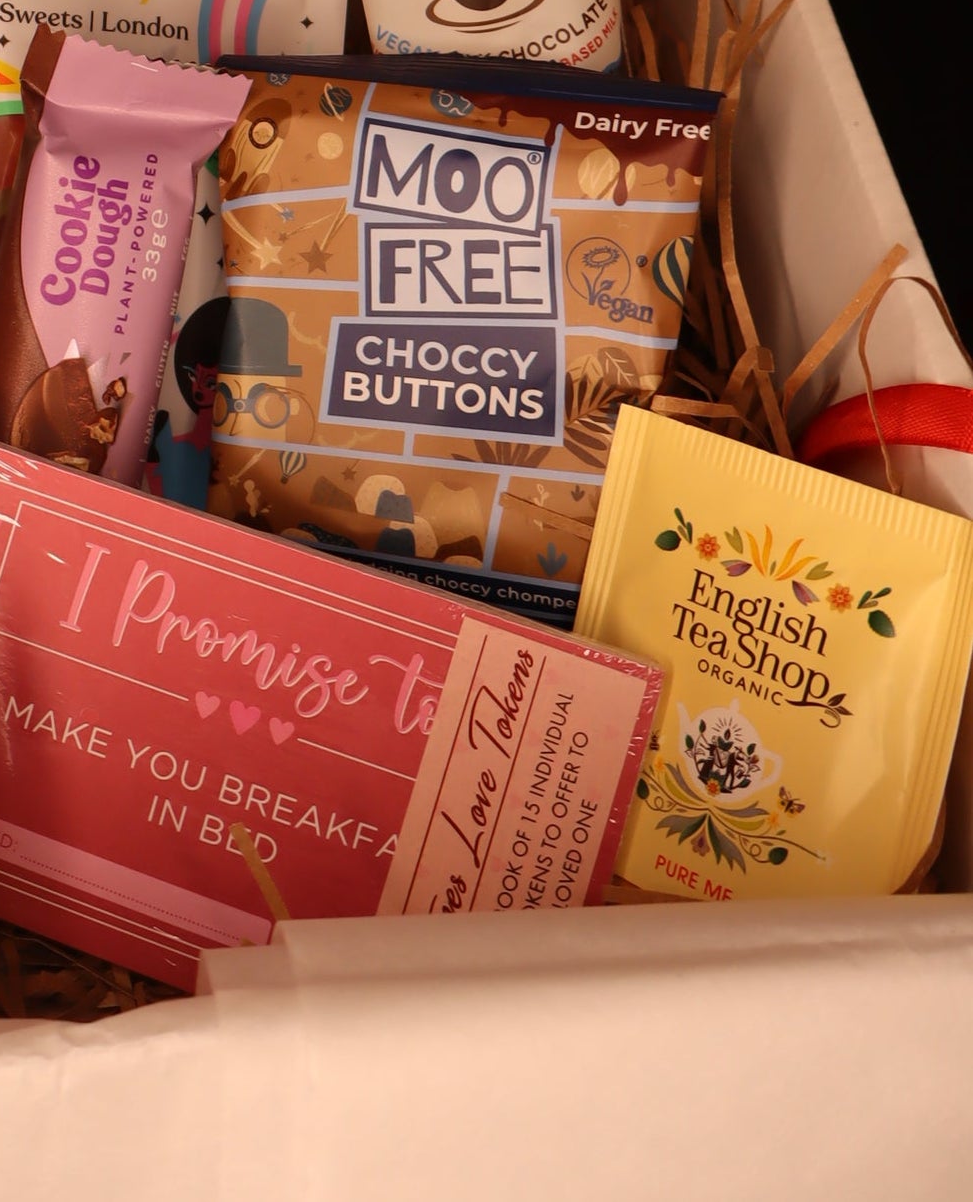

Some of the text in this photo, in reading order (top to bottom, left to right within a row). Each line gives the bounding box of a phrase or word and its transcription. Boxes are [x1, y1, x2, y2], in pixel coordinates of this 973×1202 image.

[101, 11, 190, 41] London
[601, 9, 619, 39] MILK
[574, 111, 711, 141] Dairy Free
[40, 154, 101, 306] Cookie
[79, 178, 133, 296] Dough
[114, 153, 159, 335] PLANT-POWERED
[379, 239, 544, 305] FREE
[584, 282, 654, 324] Vegan
[355, 334, 538, 380] CHOCCY
[342, 371, 545, 420] BUTTONS
[424, 571, 577, 610] choccy chompe
[687, 567, 827, 657] English
[59, 541, 111, 633] I
[112, 558, 369, 719] Promise
[672, 604, 730, 661] Tea
[468, 649, 535, 759] Tokens
[697, 658, 786, 707] ORGANIC
[571, 731, 590, 757] TO
[4, 694, 401, 859] MAKE YOU BREAKFA
[551, 762, 581, 819] OFFER
[147, 795, 188, 832] IN
[440, 768, 498, 869] Love
[494, 693, 575, 912] OOK OF 15 INDIVIDUAL
[572, 798, 599, 845] ONE
[547, 823, 562, 849] TO
[654, 854, 733, 901] PURE ME
